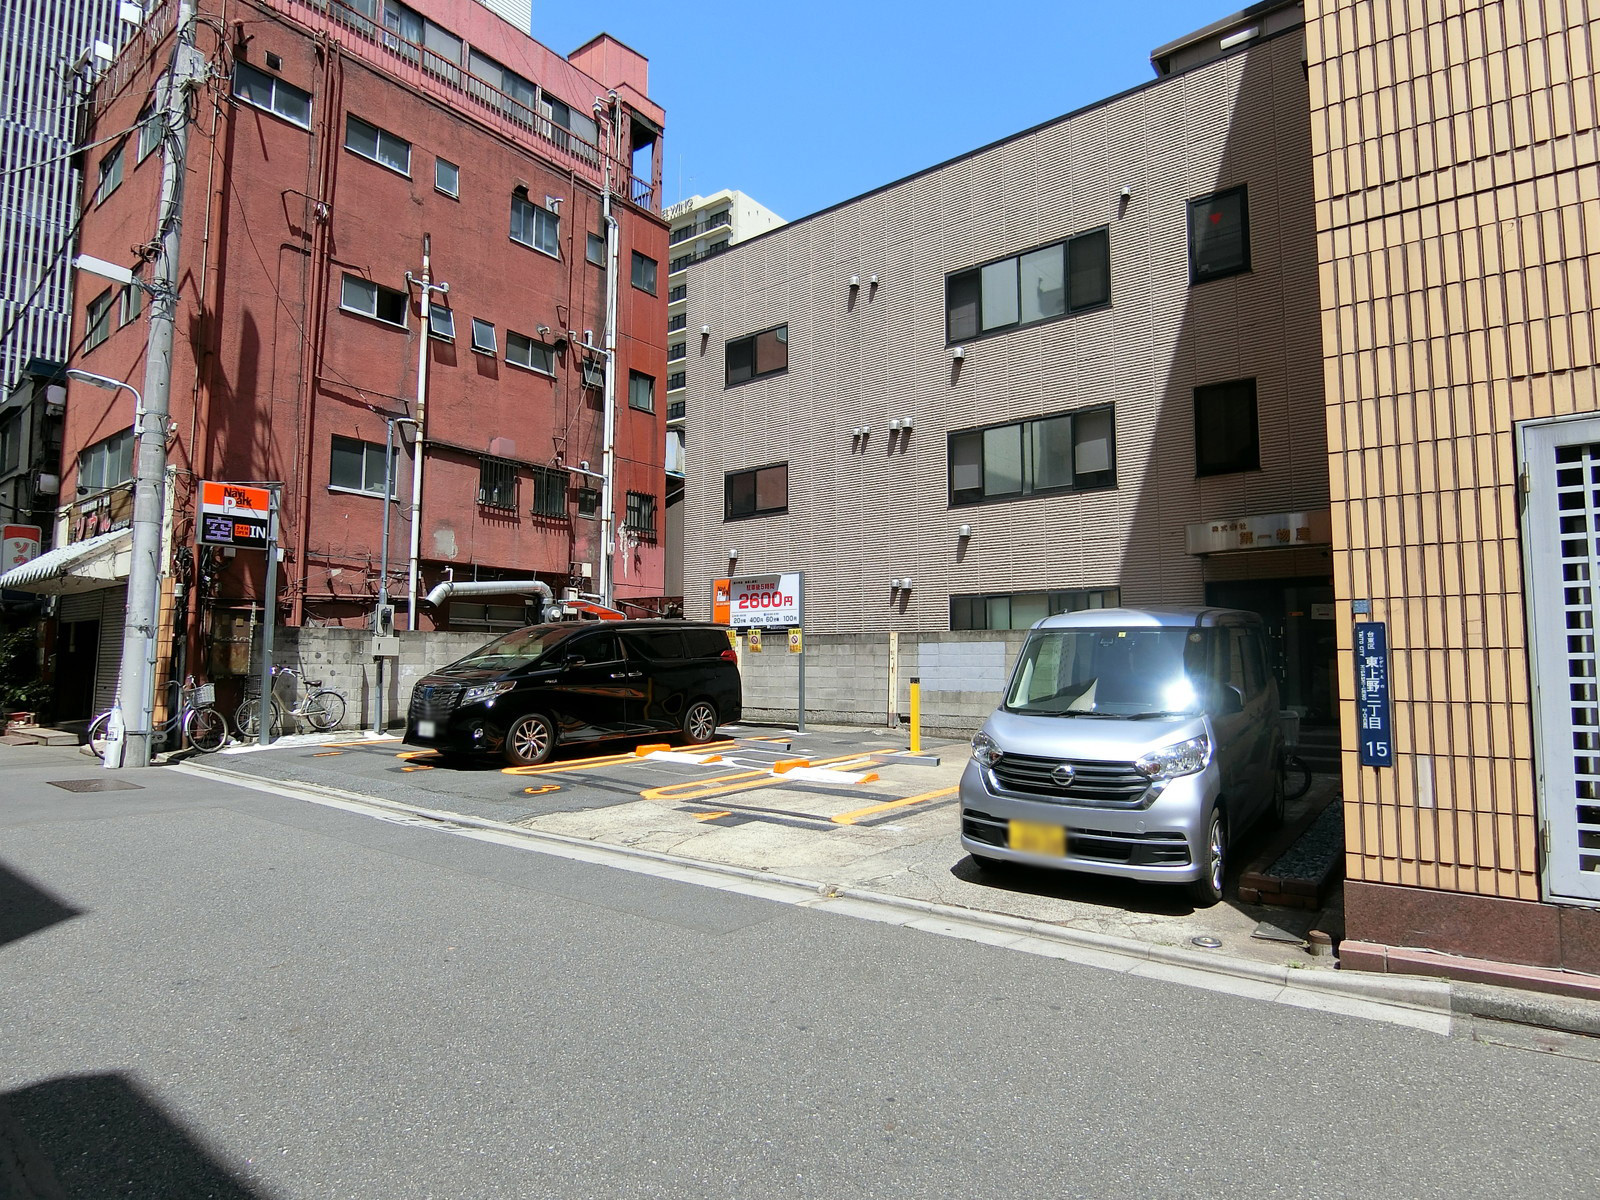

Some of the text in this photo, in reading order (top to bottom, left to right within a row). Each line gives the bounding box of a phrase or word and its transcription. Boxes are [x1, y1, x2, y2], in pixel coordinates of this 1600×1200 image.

[224, 487, 246, 498] Navi
[223, 495, 253, 514] Park
[205, 516, 233, 543] 空
[250, 525, 266, 539] IN
[1239, 527, 1311, 545] 第一物産
[738, 591, 793, 610] 2600円
[1364, 655, 1383, 731] 東上野二丁目
[1365, 741, 1388, 758] 15
